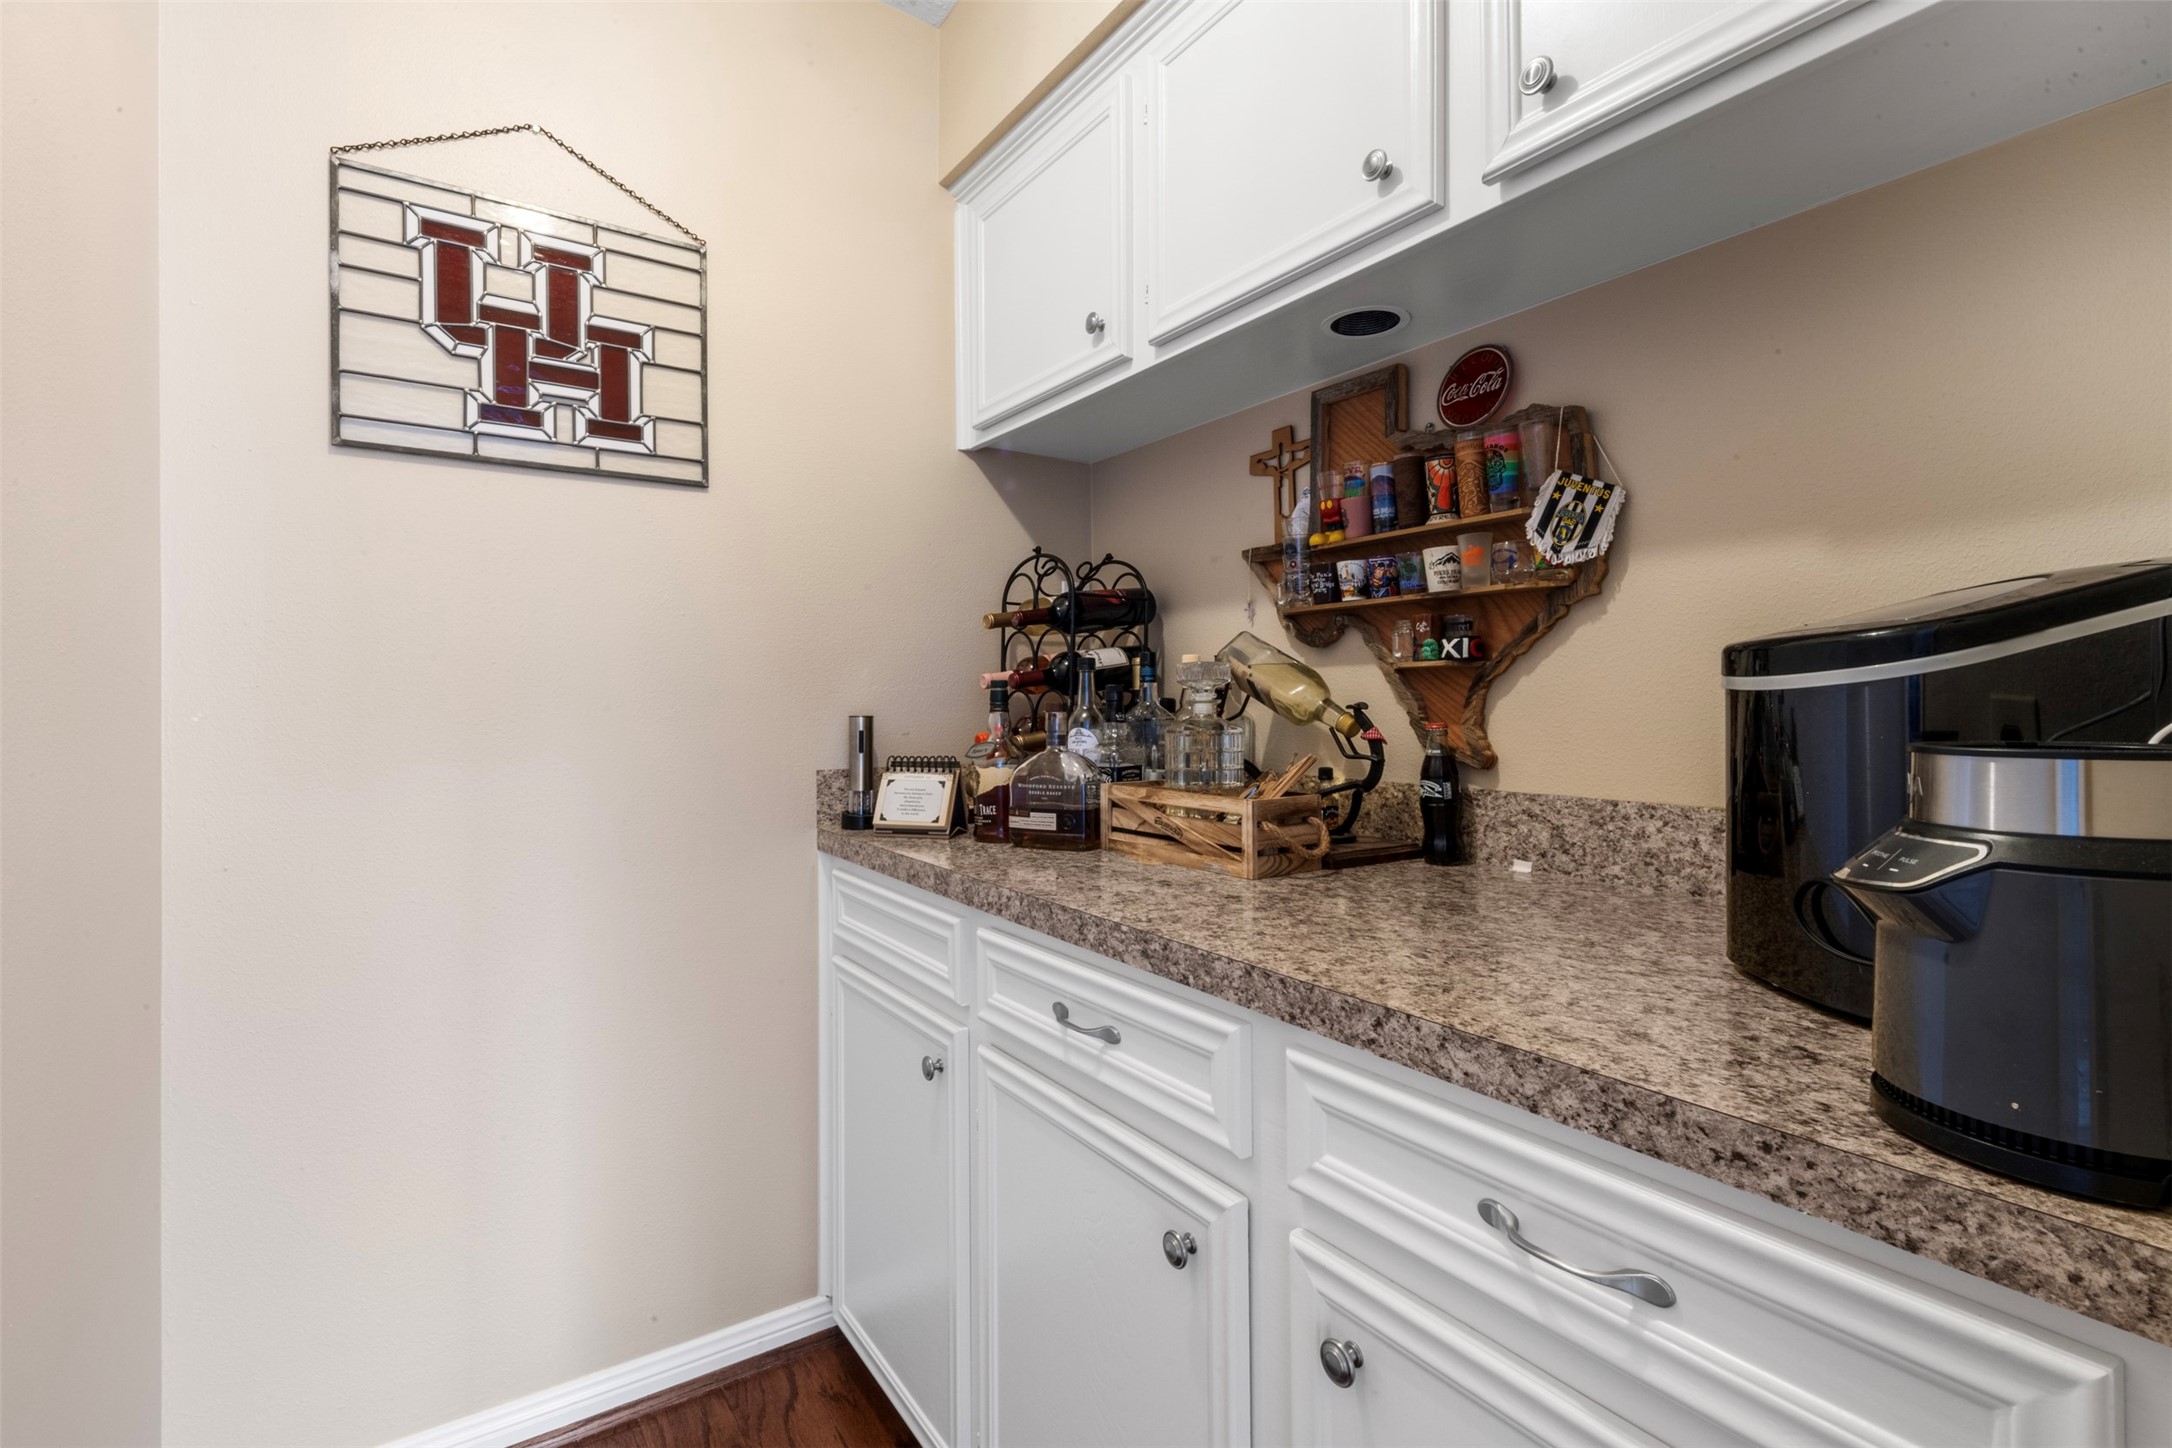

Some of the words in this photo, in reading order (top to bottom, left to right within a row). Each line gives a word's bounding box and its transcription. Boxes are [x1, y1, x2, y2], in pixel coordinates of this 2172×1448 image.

[1441, 366, 1505, 406] Coca-Cola
[1557, 477, 1612, 500] JUVENTUS
[979, 803, 997, 816] TRACE
